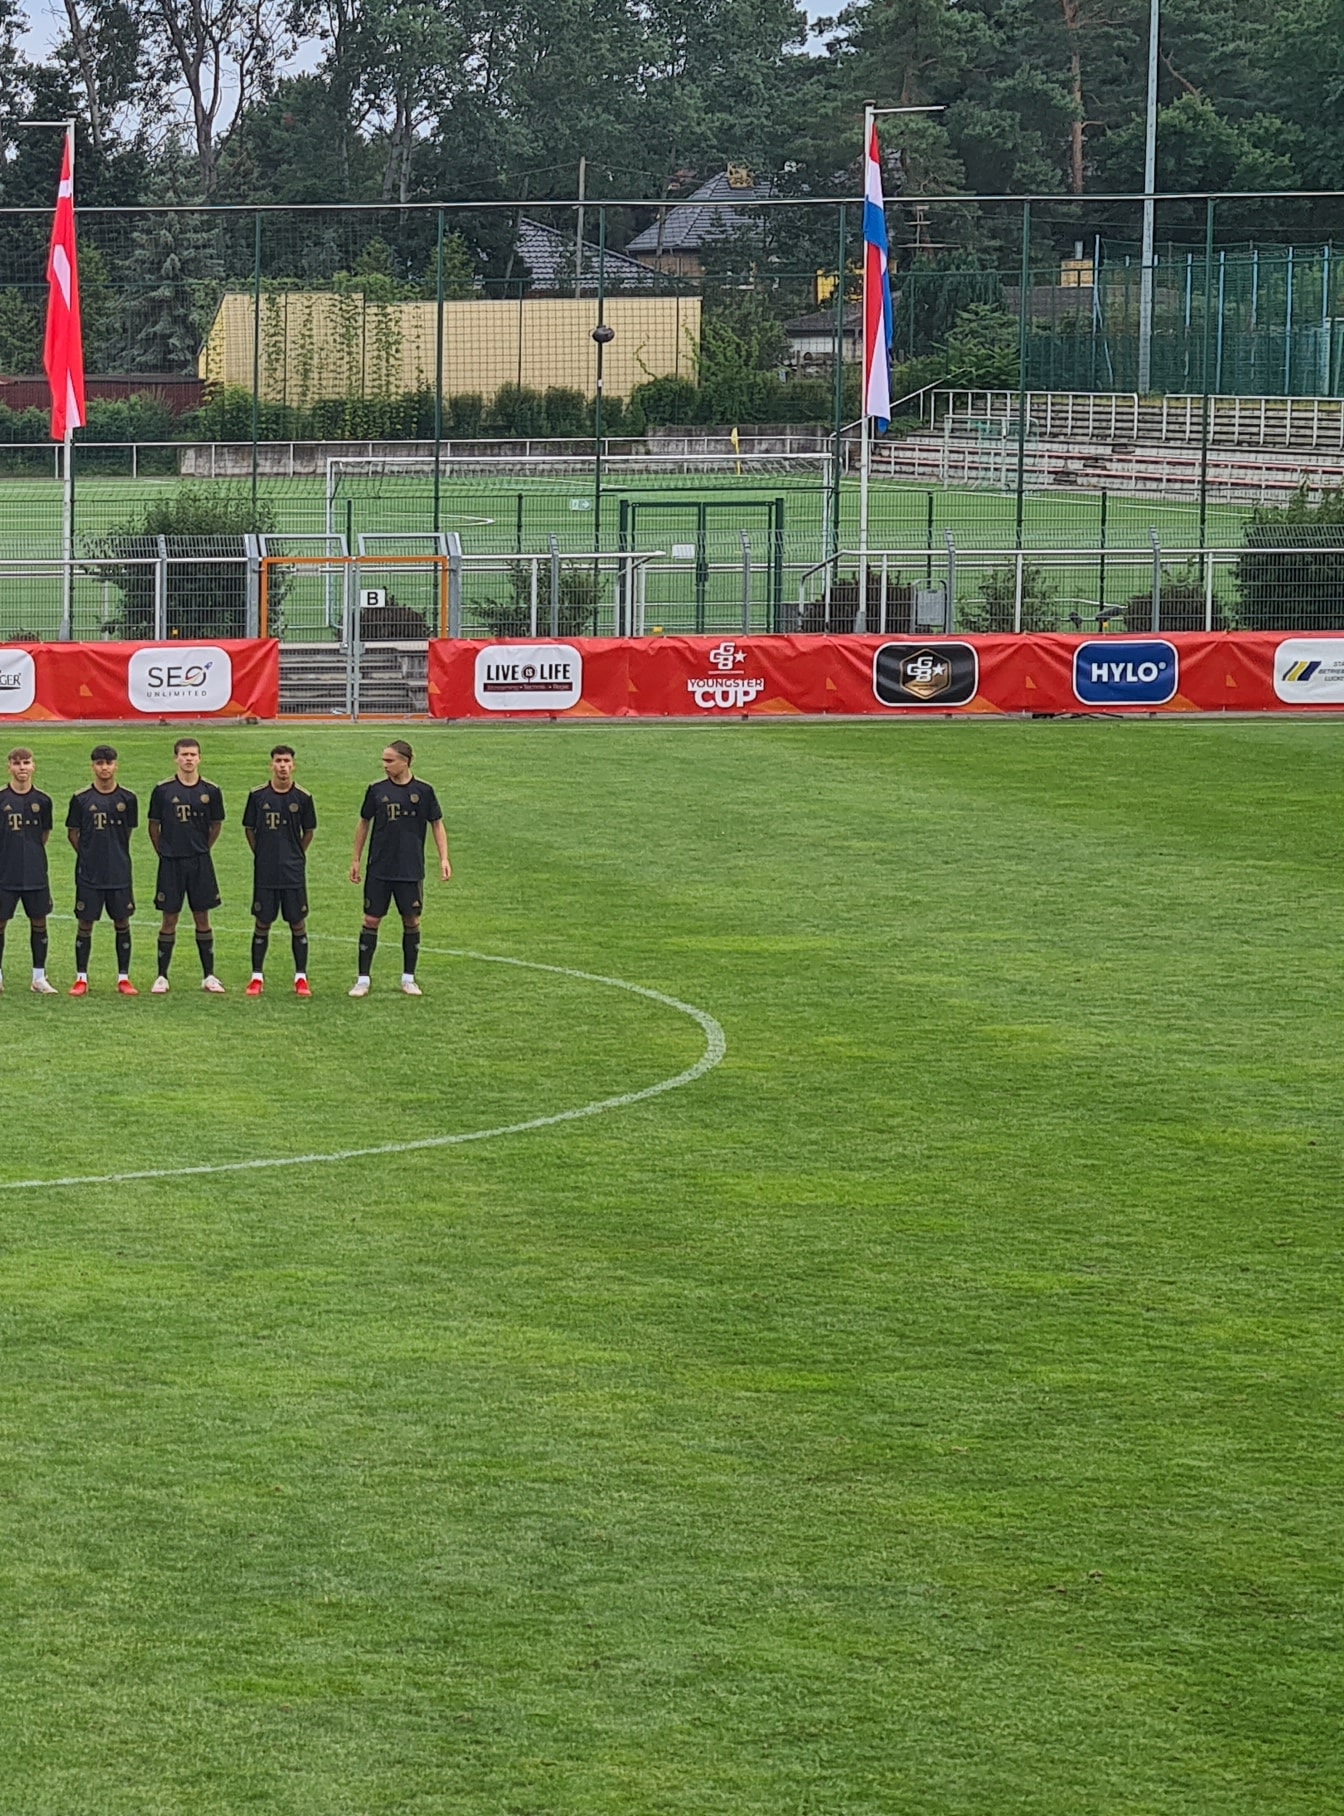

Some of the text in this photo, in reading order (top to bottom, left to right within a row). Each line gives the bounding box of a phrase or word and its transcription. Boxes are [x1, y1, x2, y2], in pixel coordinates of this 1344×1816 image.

[367, 592, 378, 605] B
[148, 666, 206, 688] SEO
[487, 665, 519, 680] LIVE
[540, 664, 570, 679] LIFE
[689, 679, 762, 688] YOUNGSTER
[694, 690, 756, 708] CUP
